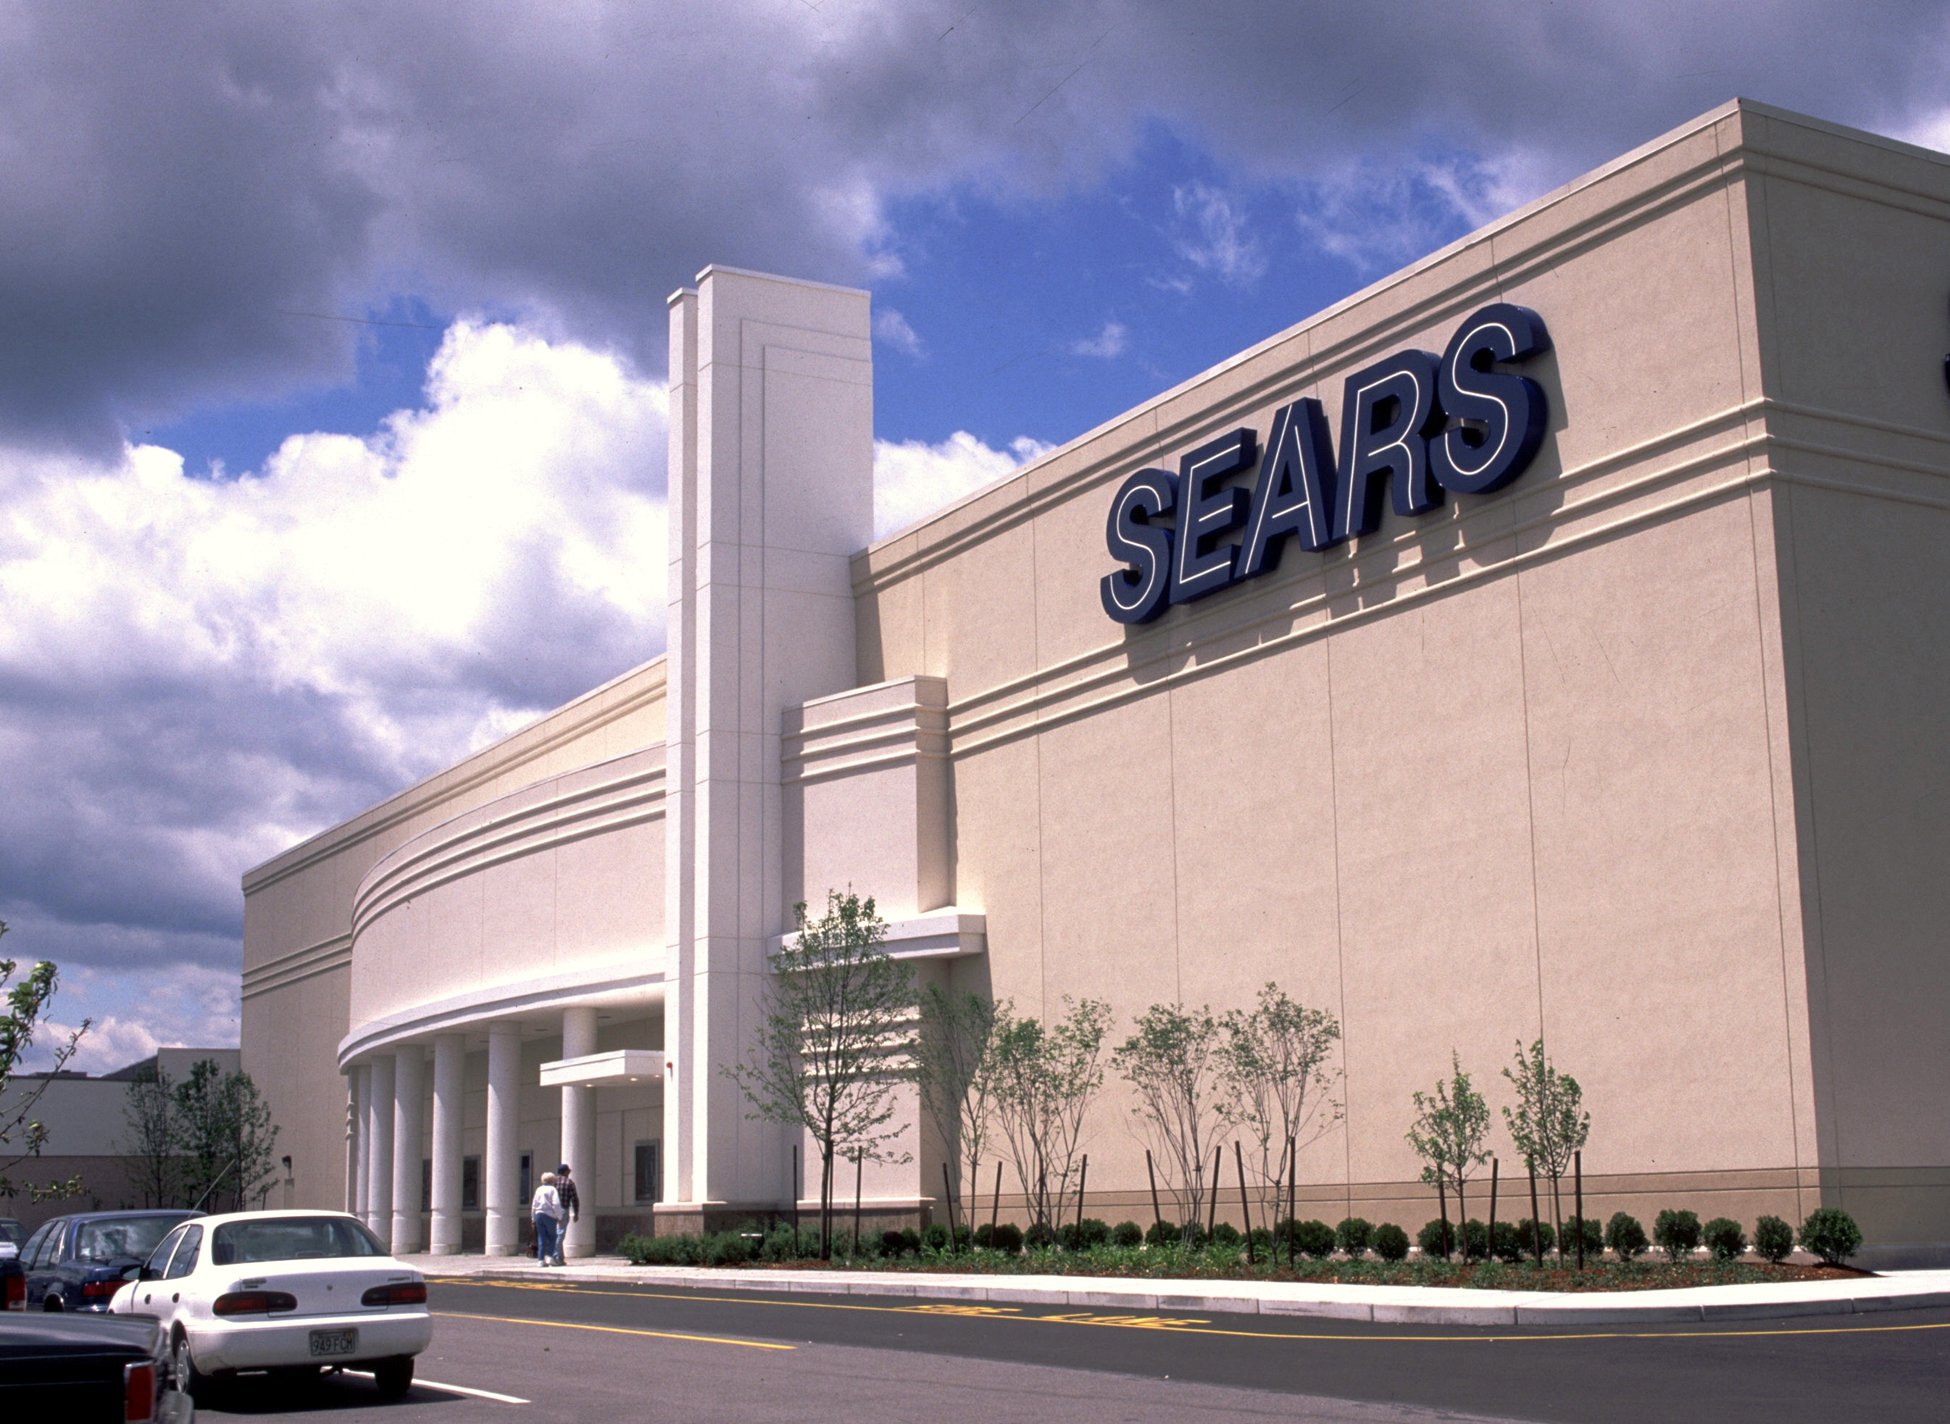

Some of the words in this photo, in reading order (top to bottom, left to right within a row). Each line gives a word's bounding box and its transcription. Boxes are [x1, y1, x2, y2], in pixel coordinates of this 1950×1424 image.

[1100, 303, 1550, 624] SEARS
[1039, 1312, 1212, 1326] LANE
[313, 1337, 332, 1352] 949
